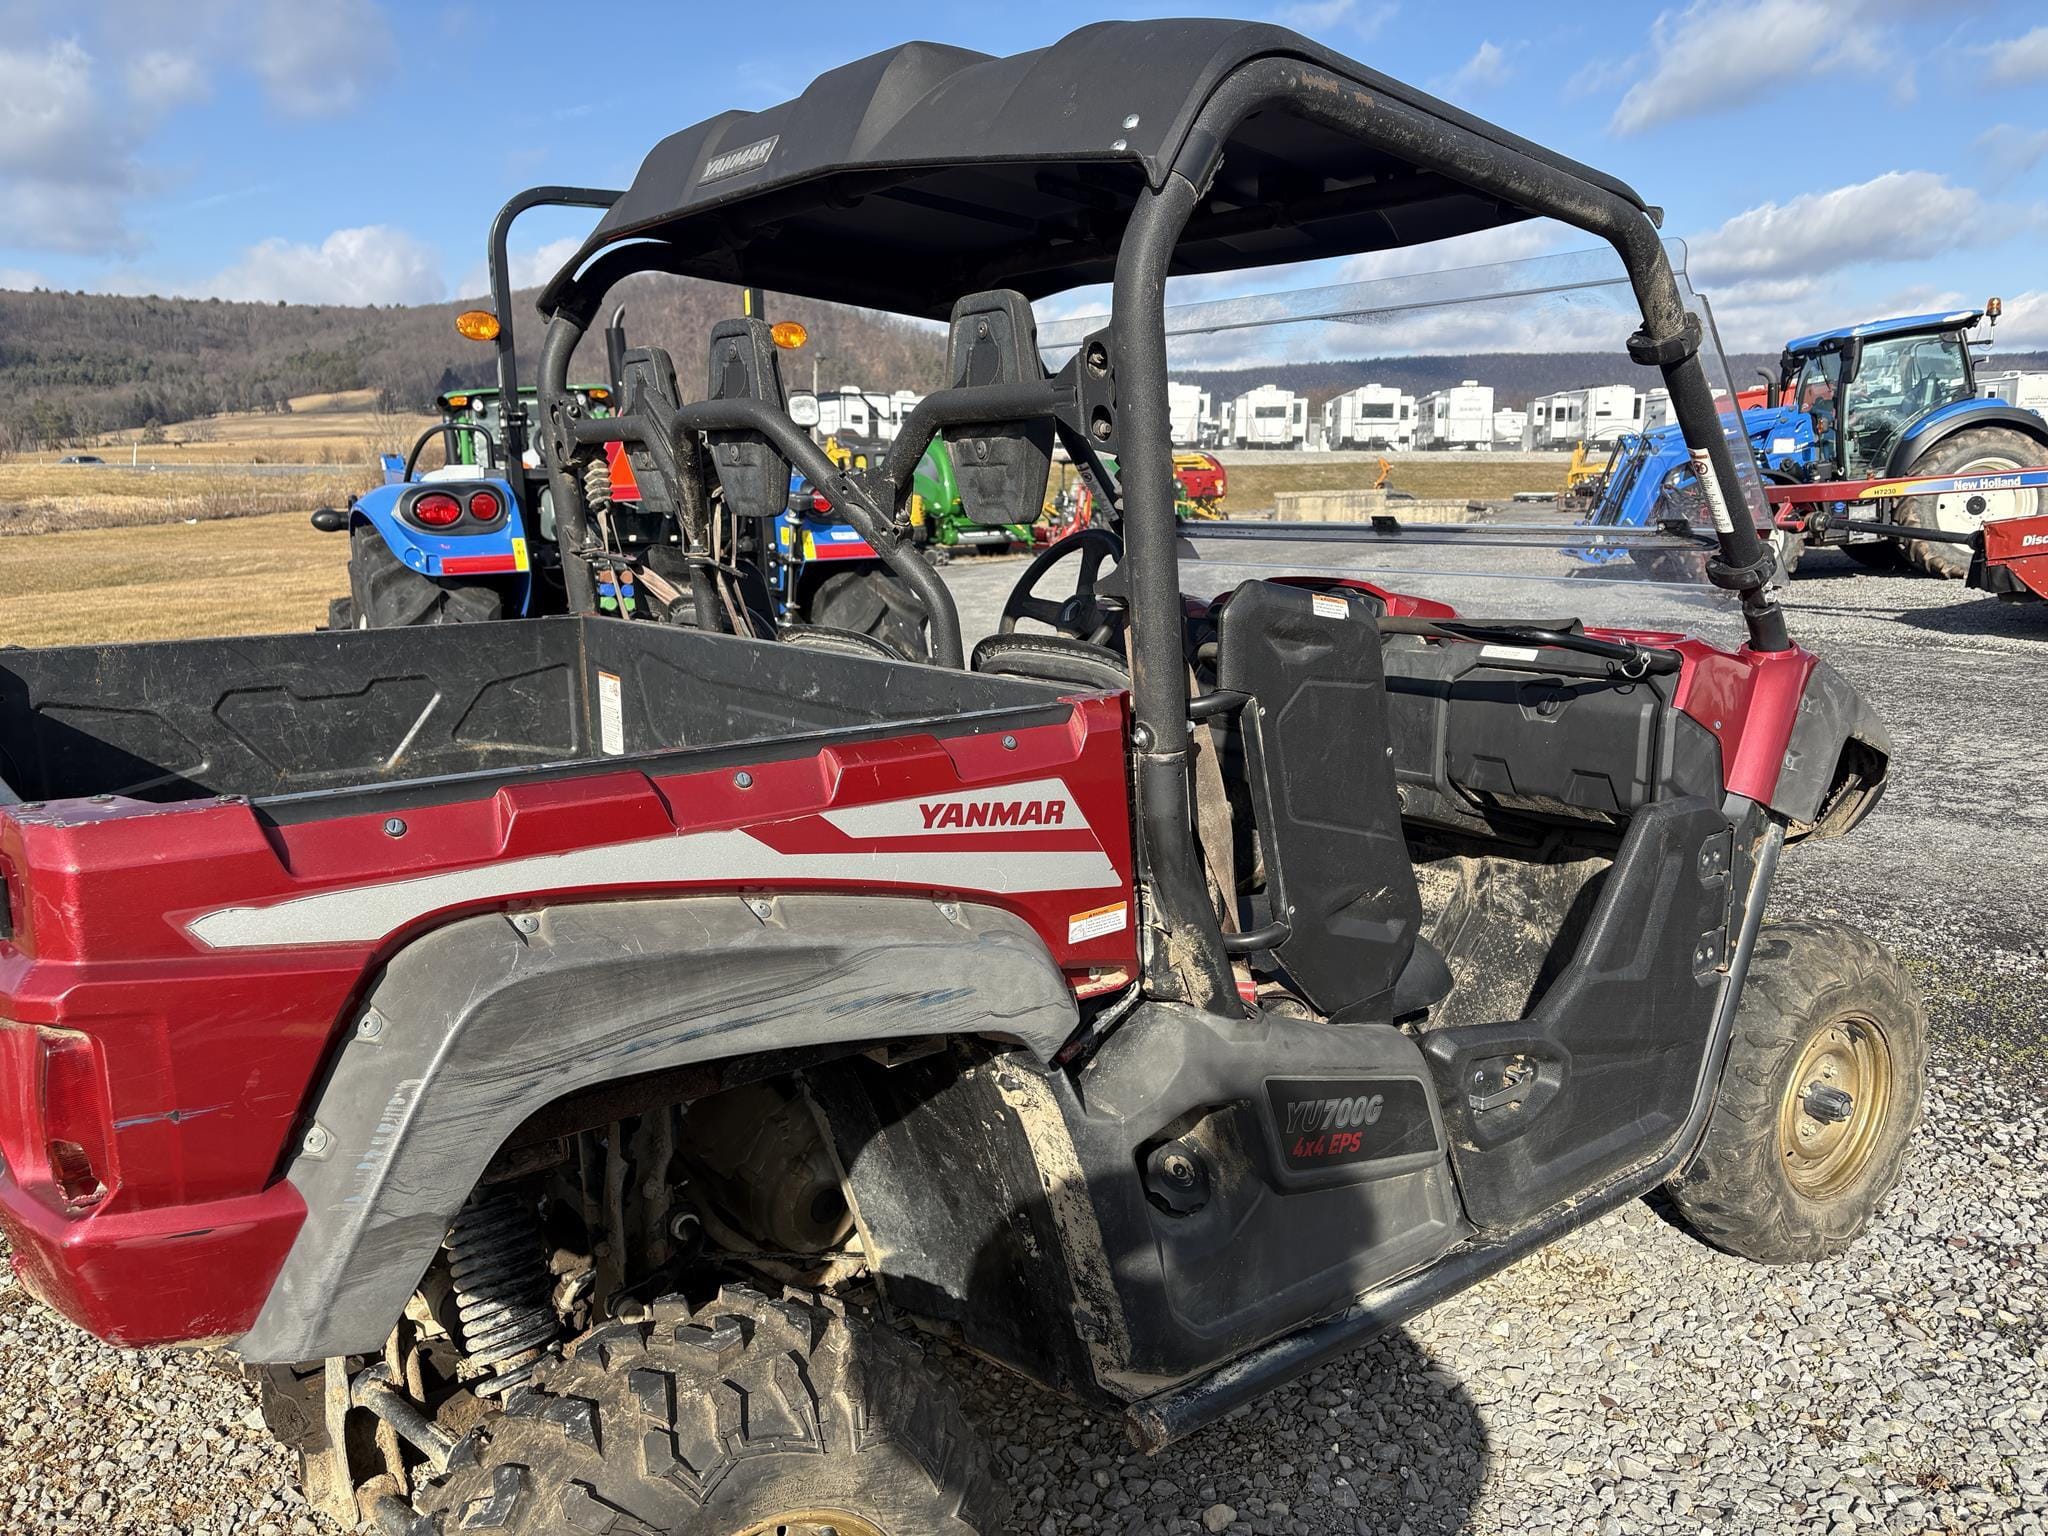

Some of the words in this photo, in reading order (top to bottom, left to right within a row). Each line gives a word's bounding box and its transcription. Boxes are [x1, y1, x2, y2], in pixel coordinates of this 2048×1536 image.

[702, 141, 772, 178] YANMAR
[1953, 480, 1978, 491] New
[1980, 476, 2021, 489] Holland
[919, 800, 1066, 829] YANMAR
[1286, 1094, 1385, 1134] YU700G
[1292, 1136, 1326, 1158] 4x4
[1327, 1131, 1364, 1155] EPS
